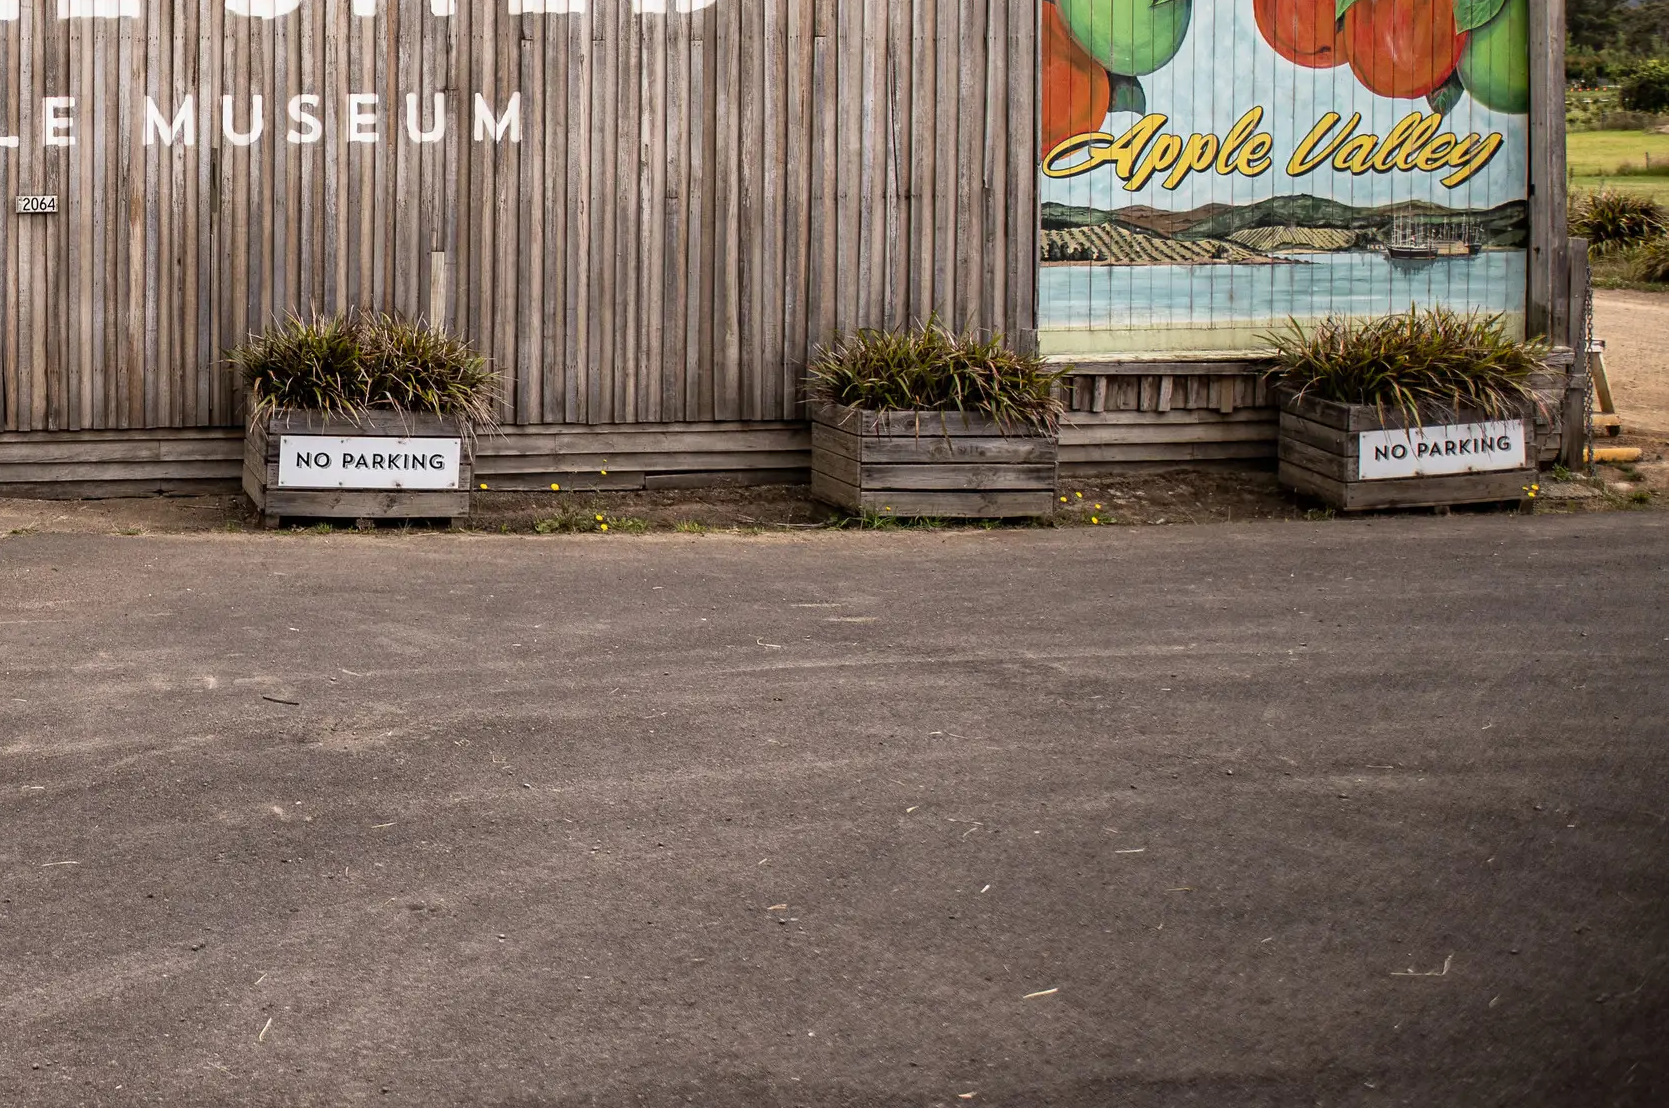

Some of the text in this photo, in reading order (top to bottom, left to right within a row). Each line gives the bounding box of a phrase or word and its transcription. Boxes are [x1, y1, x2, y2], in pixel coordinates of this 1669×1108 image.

[143, 92, 522, 147] MUSEUM
[1042, 106, 1504, 192] Apple Valley
[22, 197, 56, 211] 2064
[296, 452, 445, 470] NO PARKING
[1374, 435, 1512, 462] NO PARKING
